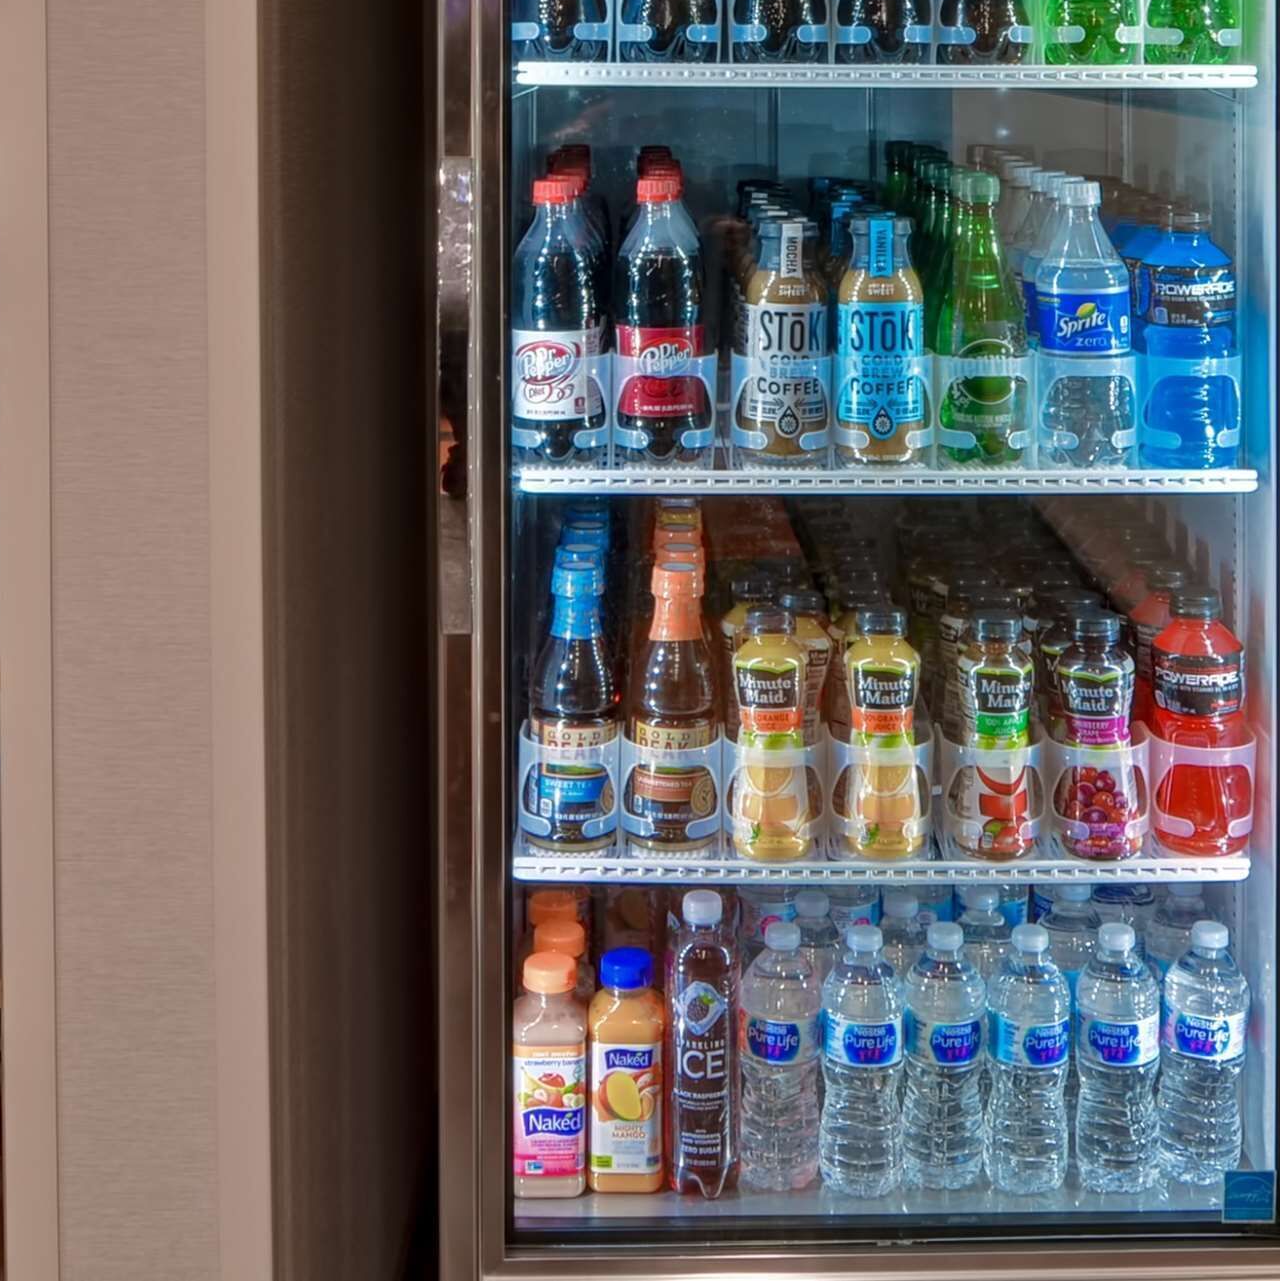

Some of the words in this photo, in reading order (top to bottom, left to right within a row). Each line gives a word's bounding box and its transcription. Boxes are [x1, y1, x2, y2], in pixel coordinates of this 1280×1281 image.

[786, 236, 799, 276] MOCHA
[1155, 280, 1235, 295] POWERADE
[1057, 311, 1106, 338] Sprite
[642, 347, 691, 375] Pepper
[756, 377, 820, 396] COFFEE
[850, 377, 914, 396] COFFEE
[739, 675, 793, 691] Minute
[1154, 668, 1240, 685] POWERADE
[745, 689, 786, 704] Maid
[548, 730, 601, 740] GOLD
[749, 1028, 776, 1050] Pure
[776, 1033, 799, 1052] Life
[845, 1033, 874, 1049] Pure
[875, 1033, 896, 1054] Life
[1090, 1034, 1120, 1049] Pure
[1120, 1034, 1141, 1055] Life
[529, 1111, 582, 1131] Naked
[612, 1131, 646, 1140] MANGO
